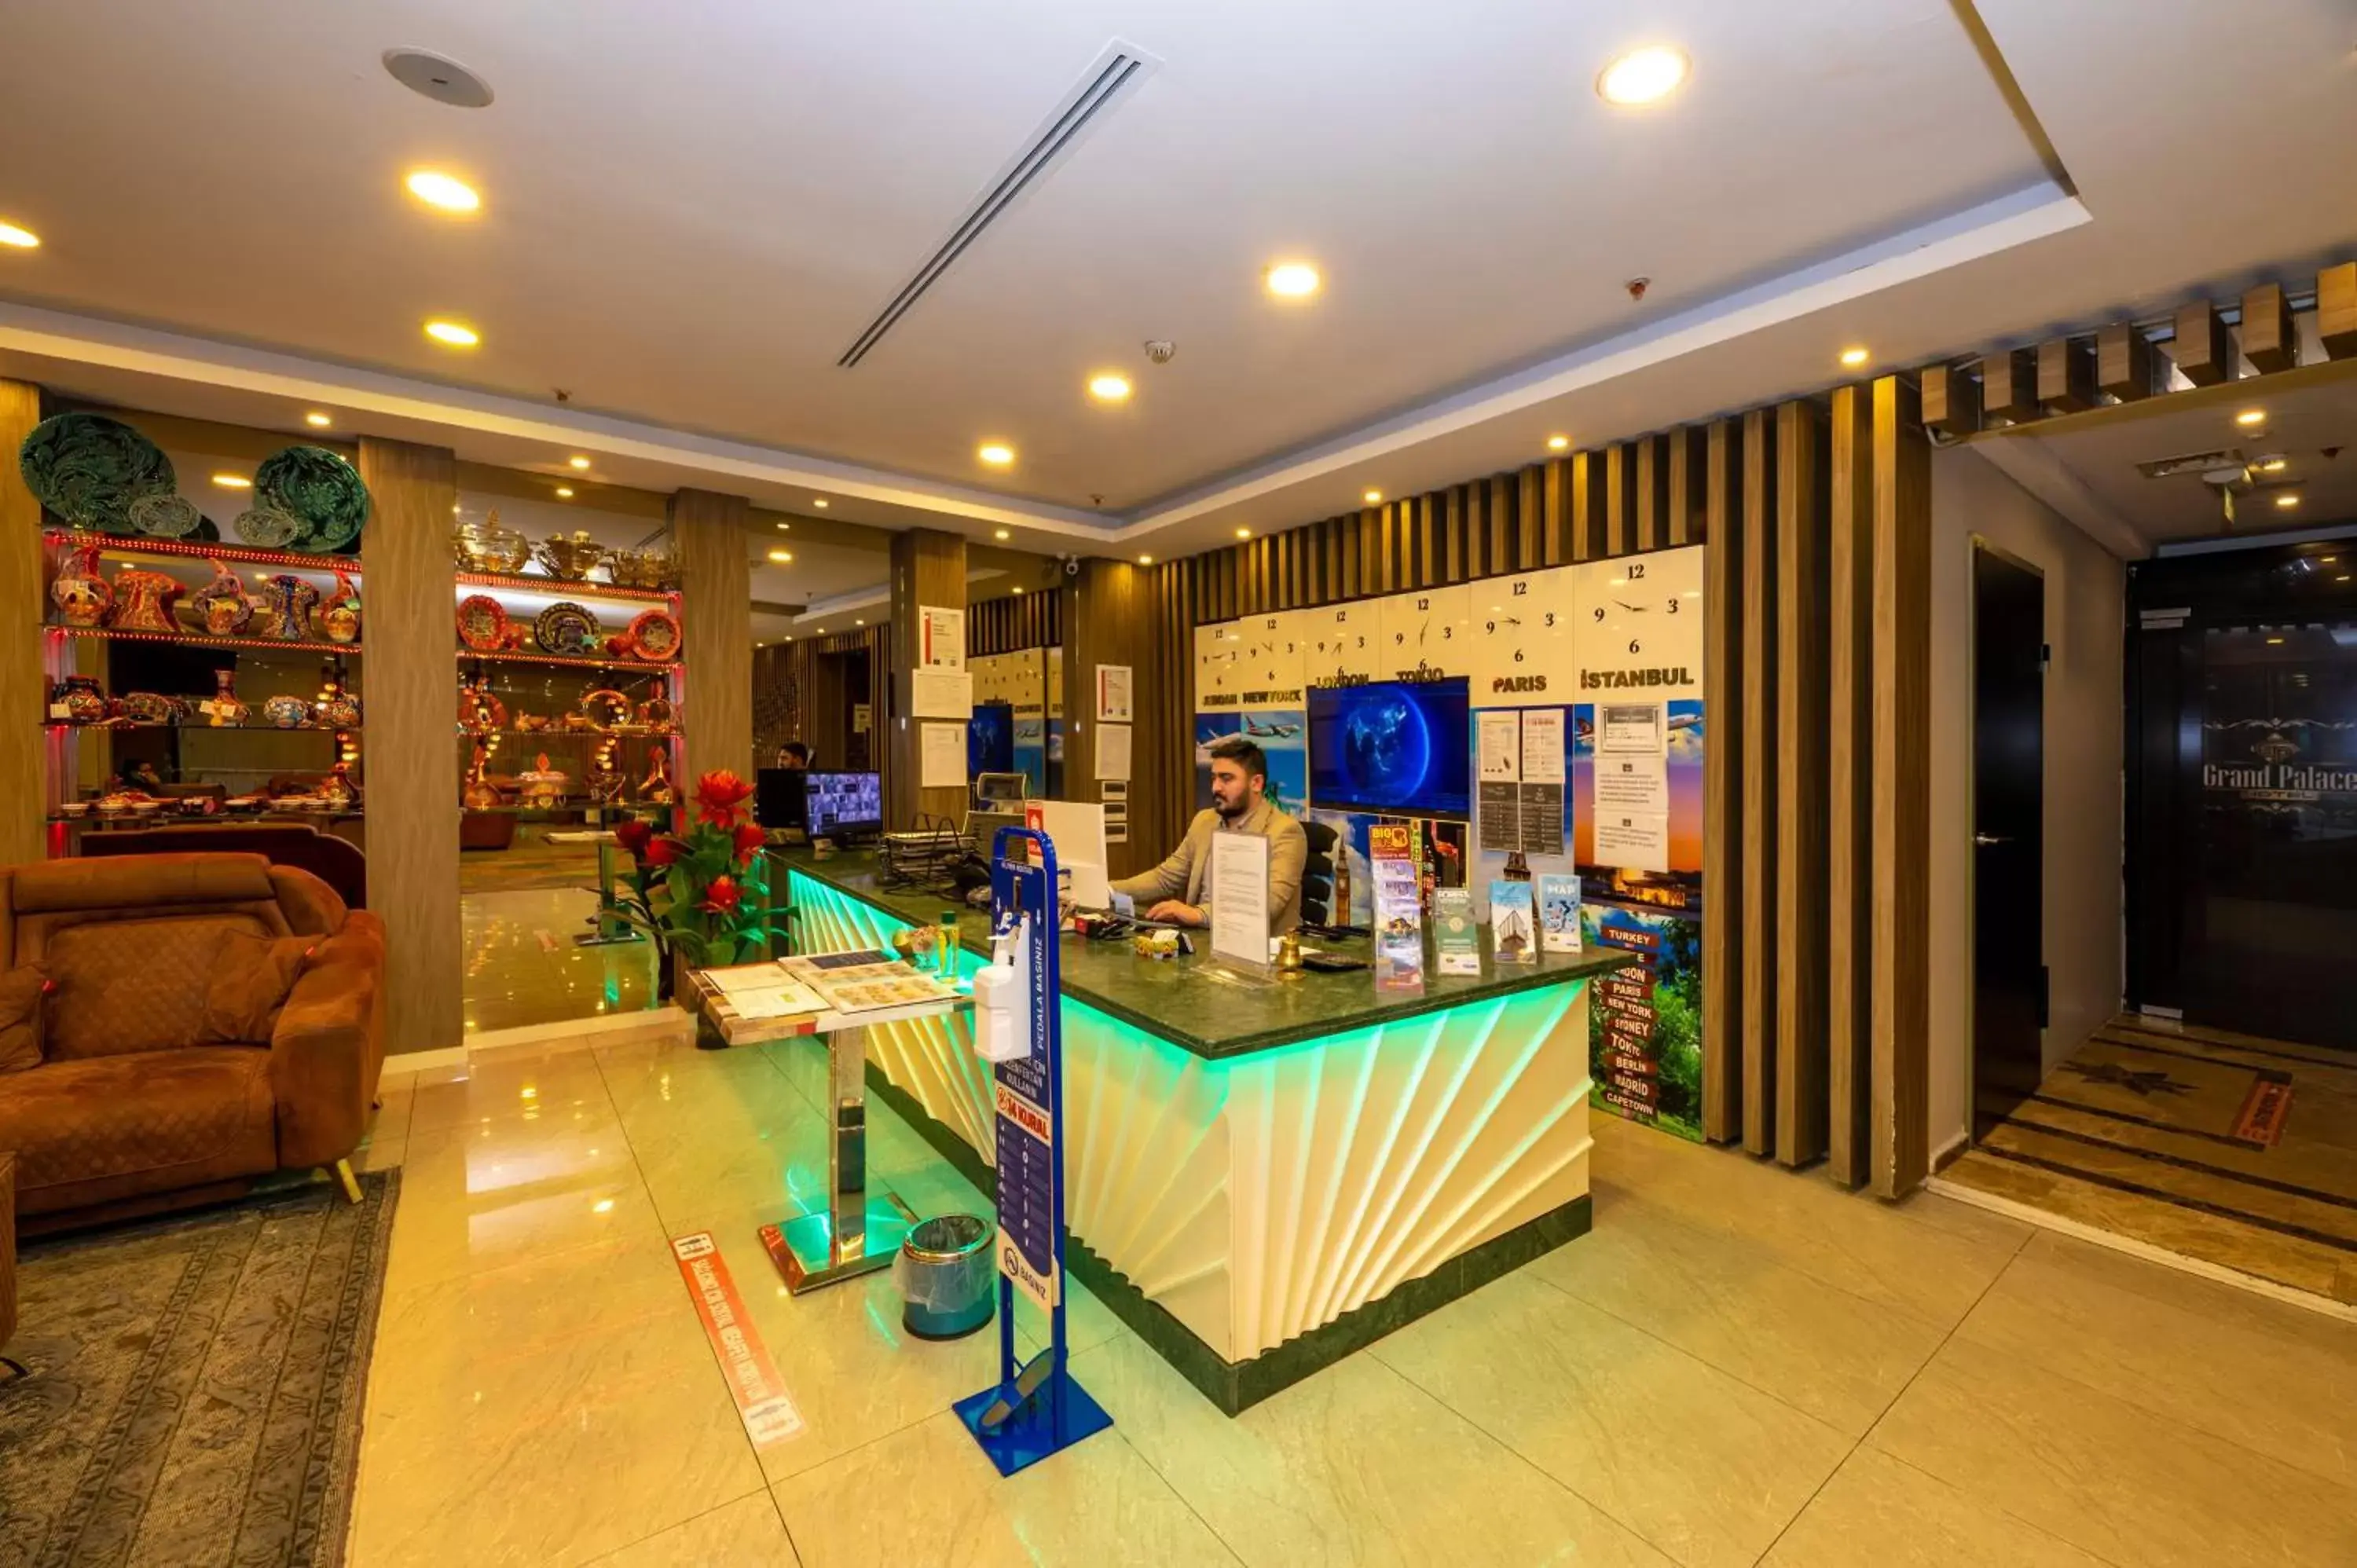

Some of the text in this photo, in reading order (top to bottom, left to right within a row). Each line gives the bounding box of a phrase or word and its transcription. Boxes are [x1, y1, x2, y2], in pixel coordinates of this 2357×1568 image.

[1628, 564, 1644, 580] 12
[1513, 582, 1527, 595] 12
[1418, 599, 1429, 610] 12
[1667, 599, 1678, 614] 3
[1336, 611, 1346, 622] 12
[1545, 613, 1554, 627] 3
[1595, 608, 1605, 622] 9
[1267, 619, 1277, 629] 12
[1486, 621, 1495, 635] 9
[1396, 633, 1403, 645] 9
[1443, 627, 1451, 639] 3
[1287, 643, 1294, 654] 3
[1318, 642, 1325, 653] 9
[1358, 636, 1365, 648] 3
[1629, 639, 1640, 654] 6
[1514, 649, 1523, 662] 6
[1268, 669, 1275, 681] 6
[1580, 668, 1694, 690] İSTANBUL
[1493, 676, 1547, 693] PARIS
[2204, 764, 2357, 790] Grand Palace
[1373, 828, 1391, 839] BIG
[1547, 884, 1575, 895] MAP
[1608, 929, 1650, 944] TURKEY
[1608, 998, 1652, 1019] NEW YORK
[1615, 1019, 1648, 1036] SYDNEY
[1611, 1032, 1641, 1056] TOKYO
[1607, 1093, 1653, 1115] CAPETOWN
